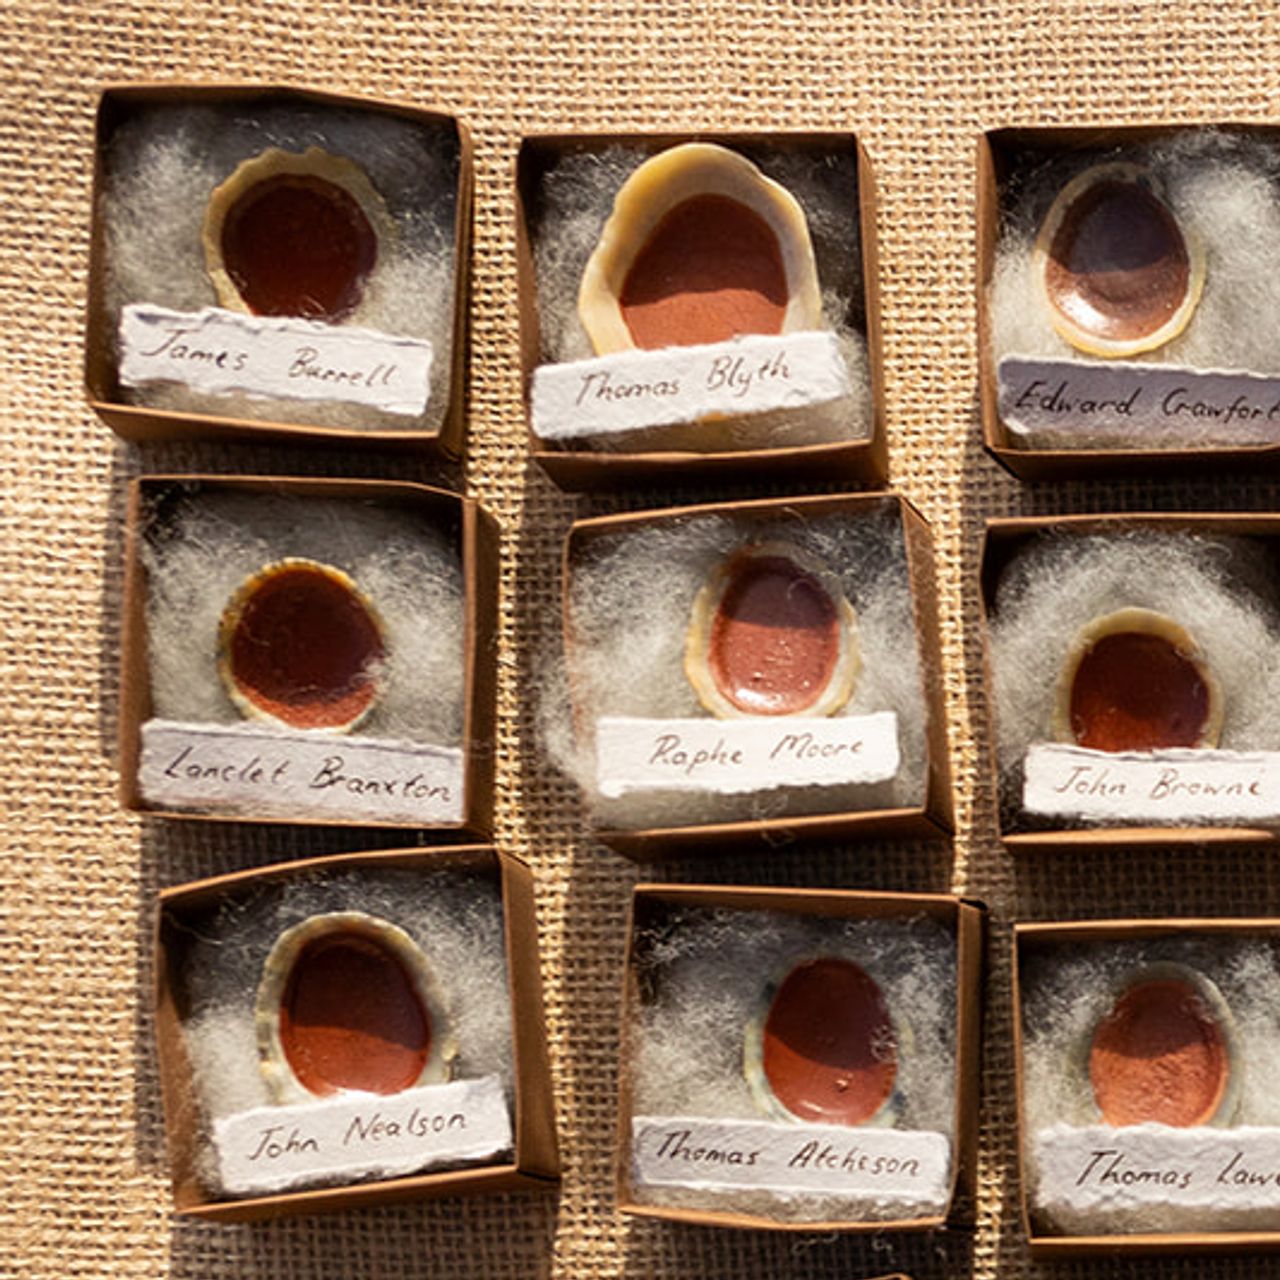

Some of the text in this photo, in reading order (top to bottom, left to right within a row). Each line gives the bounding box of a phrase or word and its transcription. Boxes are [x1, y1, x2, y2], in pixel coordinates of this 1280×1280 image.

[146, 330, 247, 371] James
[577, 356, 789, 402] Thomas Blyth
[1013, 383, 1140, 419] Edward
[650, 734, 862, 772] Raphe Moore
[1056, 764, 1261, 798] John Browne
[249, 1110, 466, 1160] John Nealson
[656, 1132, 760, 1166] Thomas
[1076, 1151, 1191, 1189] Thomas
